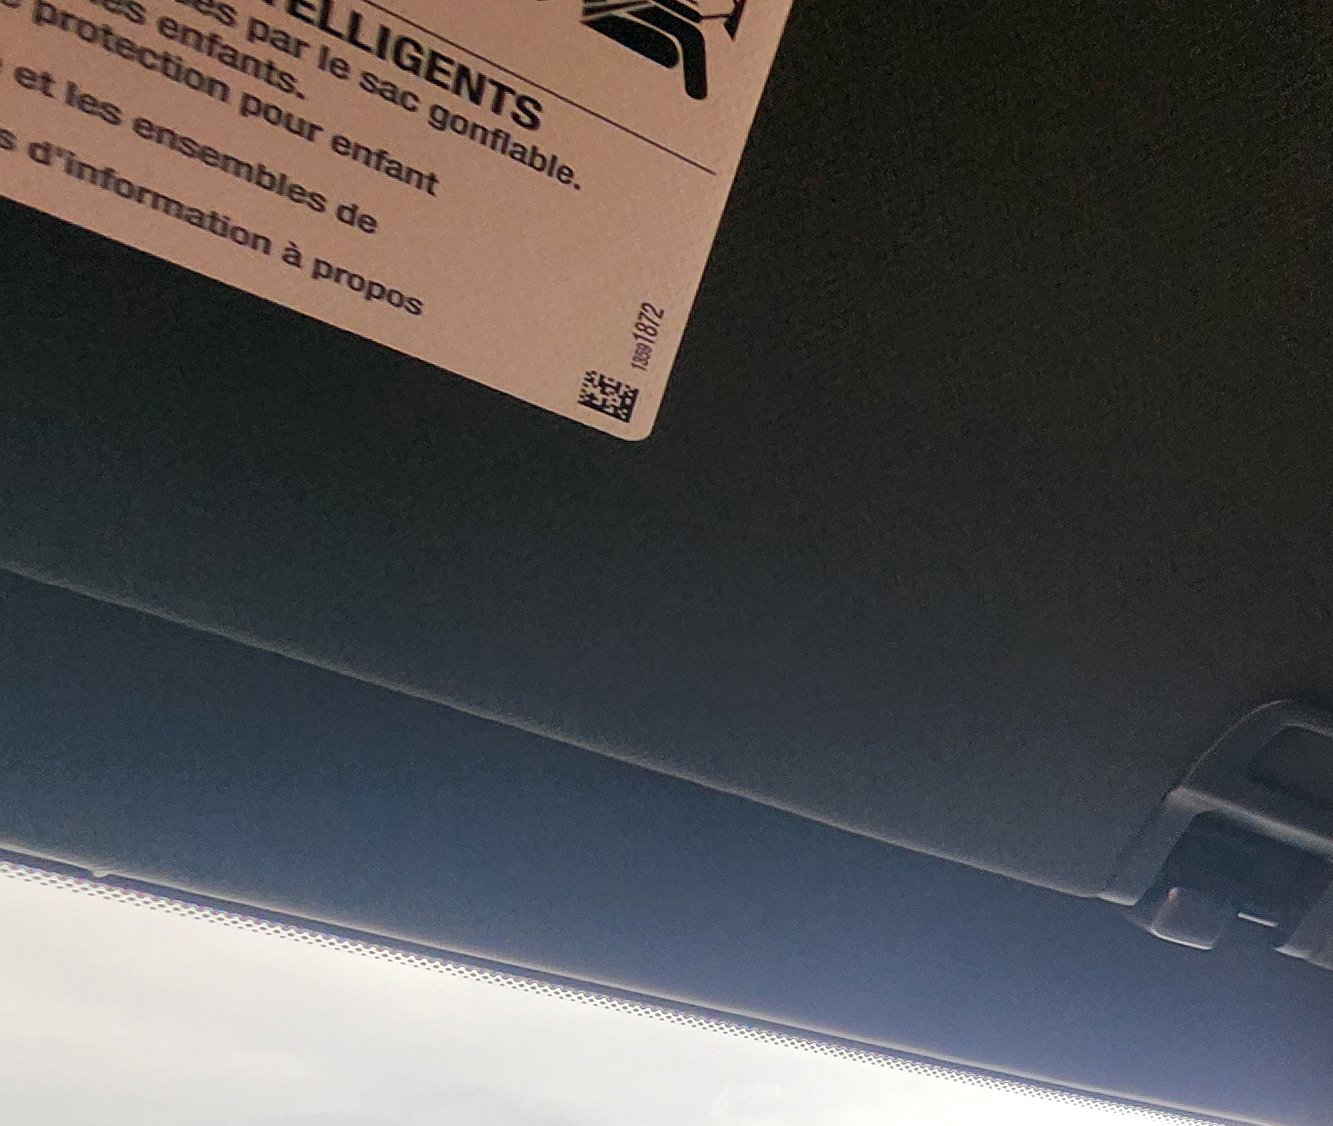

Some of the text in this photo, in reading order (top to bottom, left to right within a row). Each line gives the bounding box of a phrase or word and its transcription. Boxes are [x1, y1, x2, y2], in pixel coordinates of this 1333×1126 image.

[32, 0, 440, 197] protection pour enfant
[156, 15, 305, 100] enfants.
[247, 16, 309, 59] par
[318, 45, 350, 80] le
[359, 70, 420, 113] sac
[428, 103, 581, 191] gonflable.
[14, 65, 379, 235] et les ensembles de
[28, 140, 272, 256] d'information
[282, 241, 303, 269] à
[312, 257, 424, 316] propos
